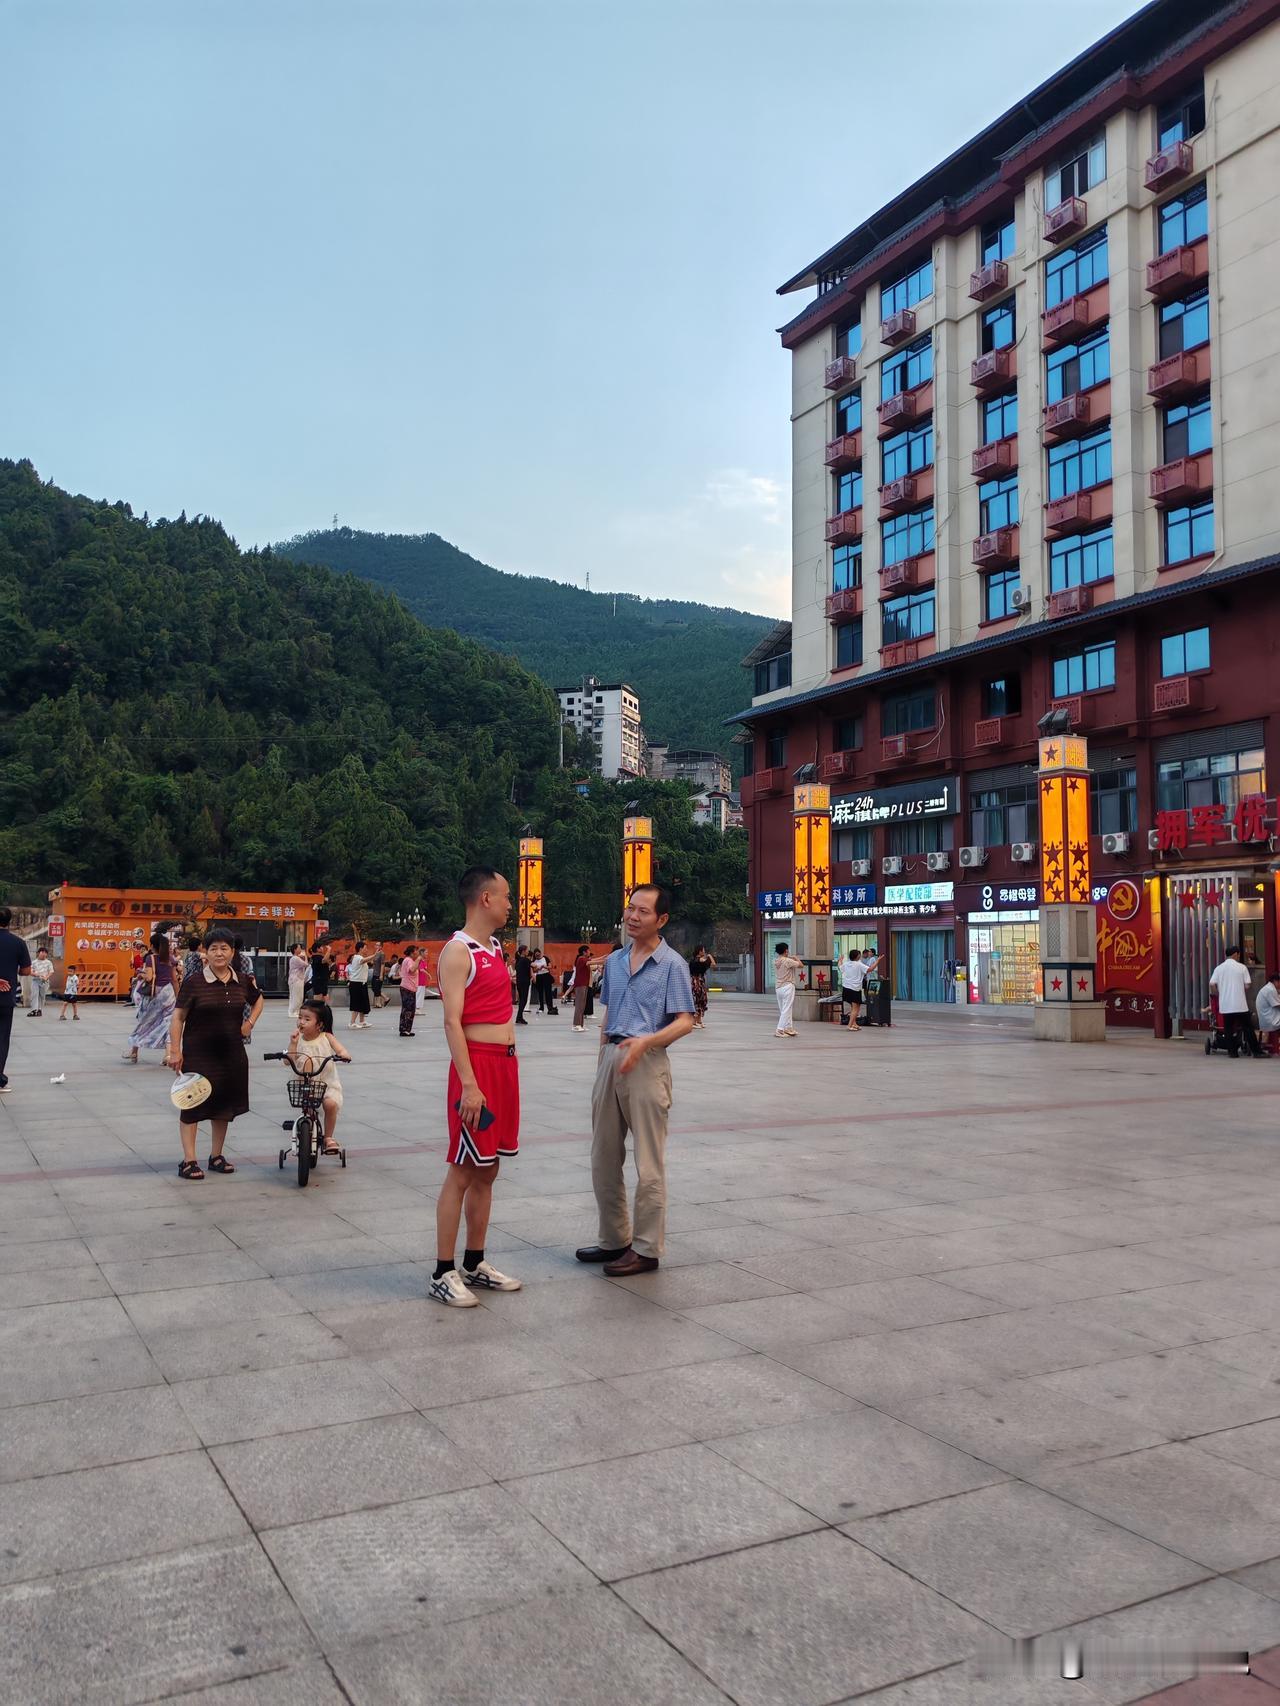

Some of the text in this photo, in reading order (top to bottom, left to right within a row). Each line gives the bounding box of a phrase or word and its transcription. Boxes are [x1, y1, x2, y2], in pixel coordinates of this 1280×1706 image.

[855, 796, 874, 811] 24h
[829, 799, 856, 824] 麻
[890, 800, 923, 817] PLUS
[1156, 794, 1280, 850] 拥军优
[832, 888, 867, 903] 科诊所
[1092, 886, 1108, 901] ge
[245, 905, 296, 917] 工会驿站
